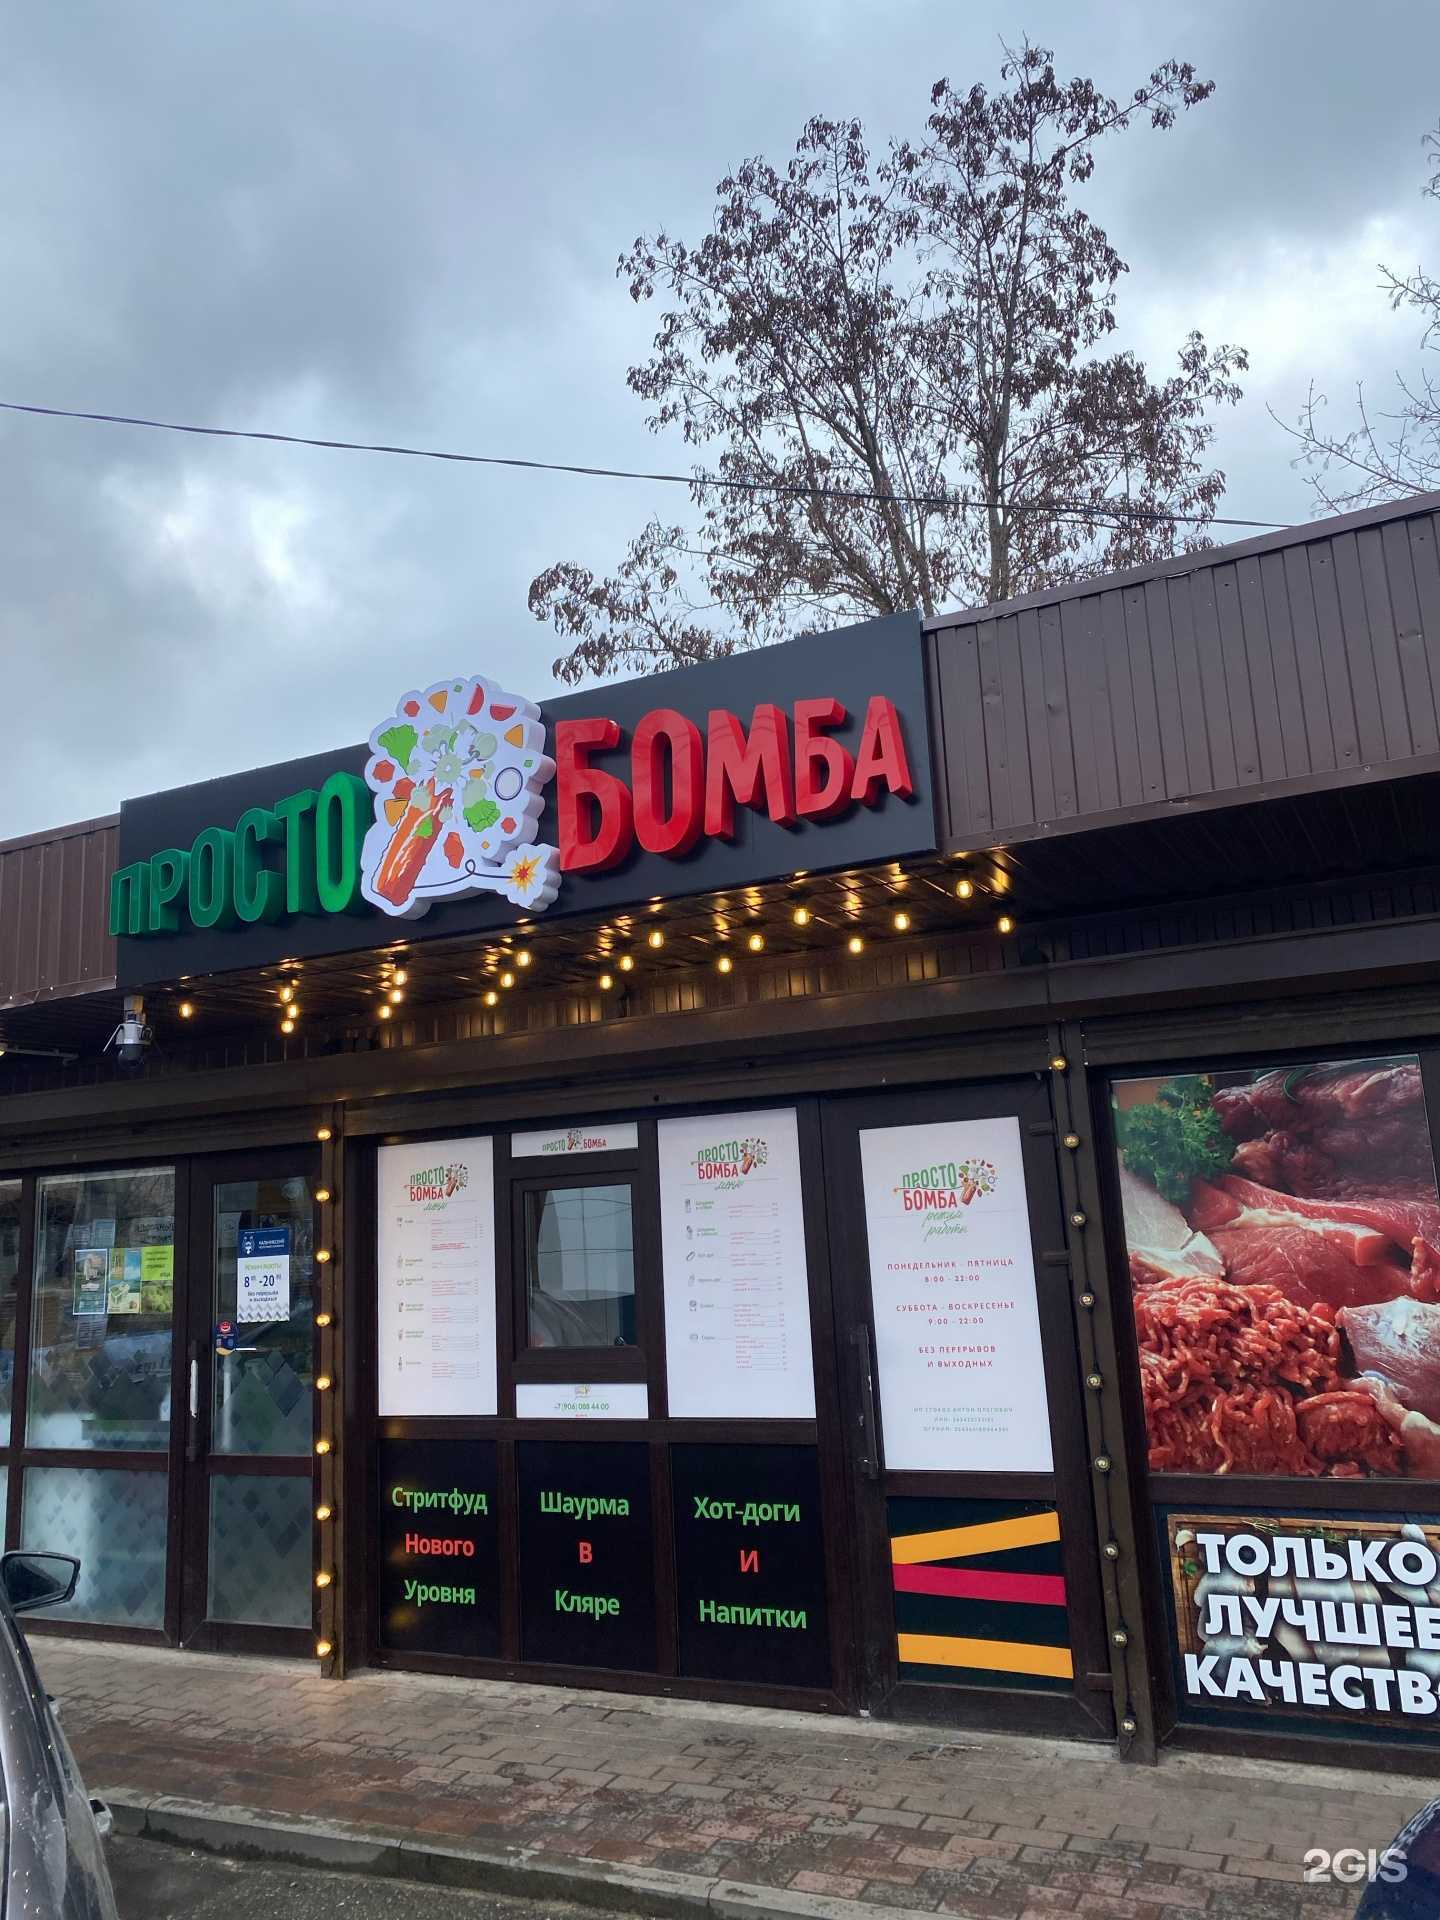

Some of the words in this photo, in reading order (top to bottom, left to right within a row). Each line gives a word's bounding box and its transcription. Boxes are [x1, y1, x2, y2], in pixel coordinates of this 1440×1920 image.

[109, 772, 369, 936] ПРОСТО
[555, 696, 912, 873] БОМБА
[542, 1139, 566, 1152] ПРОСТО
[583, 1138, 607, 1149] БОМБА
[697, 1141, 740, 1162] ПРОСТО
[410, 1166, 445, 1186] ПРОСТО
[698, 1162, 739, 1180] БОМБА
[902, 1163, 958, 1188] ПРОСТО
[410, 1186, 444, 1201] БОМБА
[903, 1189, 958, 1211] БОМБА
[887, 1261, 957, 1271] ПОНЕДЕЛЬНИК
[967, 1258, 1014, 1268] ПЯТНИЦА
[896, 1304, 938, 1312] СУББОТА
[948, 1301, 1015, 1311] ВОСКРЕСЕНЬЕ
[919, 1346, 935, 1354] БЕЗ
[939, 1345, 996, 1354] ПЕРЕРЫВОВ
[927, 1360, 934, 1368] И
[937, 1360, 993, 1369] ВЫХОДНЫХ
[391, 1486, 489, 1515] Стритфуд
[540, 1491, 630, 1520] Шаурма
[694, 1497, 801, 1526] Хот-доги
[404, 1533, 475, 1557] Нового
[579, 1541, 593, 1564] В
[740, 1550, 759, 1573] И
[1196, 1533, 1437, 1586] ТОЛЬКО
[404, 1579, 476, 1606] Уровня
[555, 1590, 620, 1620] Кляре
[699, 1600, 807, 1630] Напитки
[1205, 1594, 1440, 1650] ЛУЧШЕЕ
[1184, 1653, 1440, 1715] КАЧЕСТВ
